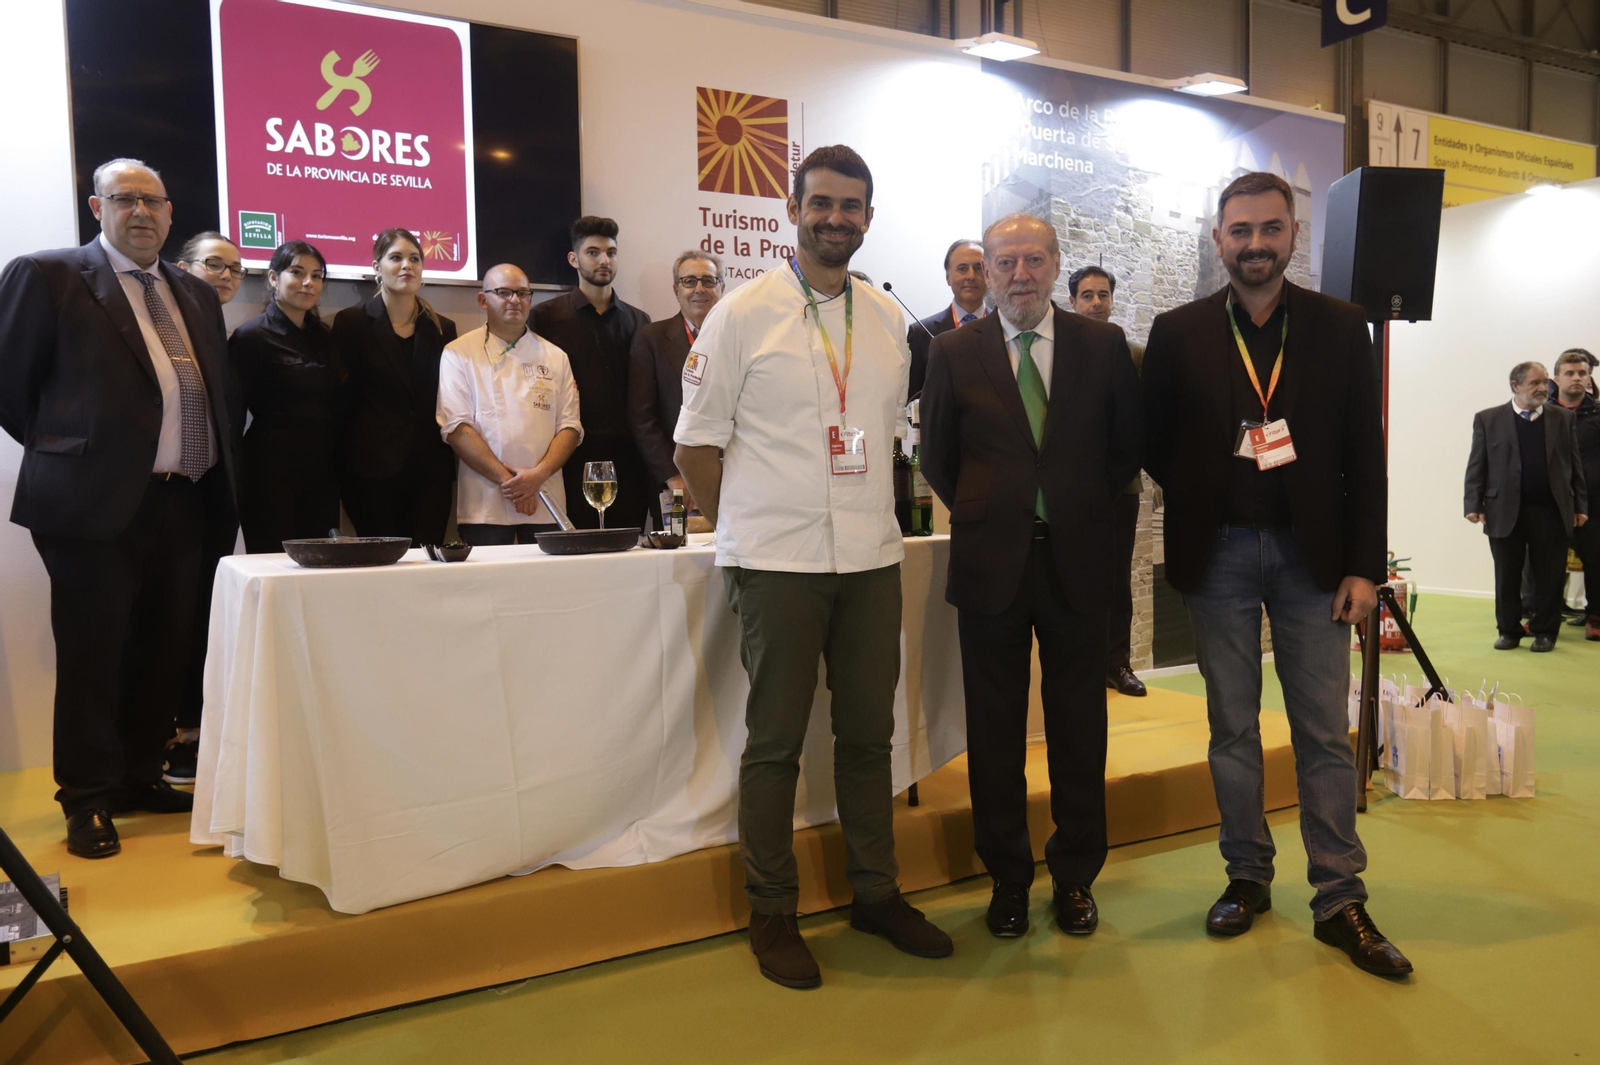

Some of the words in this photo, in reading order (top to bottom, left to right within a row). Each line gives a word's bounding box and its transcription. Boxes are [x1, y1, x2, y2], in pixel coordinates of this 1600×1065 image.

[1058, 100, 1080, 120] de
[1084, 104, 1099, 122] la
[1376, 112, 1384, 131] 9
[265, 117, 431, 168] SABORES
[1020, 120, 1076, 145] Puerta
[1080, 131, 1103, 150] de
[1412, 128, 1421, 161] 7
[1013, 147, 1094, 175] Marchena
[1433, 135, 1468, 151] Entidades
[1475, 143, 1514, 159] Organismos
[1515, 150, 1543, 165] Oficiales
[1543, 155, 1575, 170] Españoles
[266, 162, 283, 176] DE
[286, 164, 302, 178] LA
[304, 165, 370, 184] PROVINCIA
[372, 172, 388, 186] DE
[390, 174, 433, 190] SEVILLA
[1433, 155, 1460, 169] Spanish
[1461, 160, 1497, 176] Promotion
[1497, 167, 1520, 180] Boards
[698, 206, 779, 233] Turismo
[244, 232, 272, 240] SEVILLA
[700, 233, 725, 255] de
[734, 235, 751, 257] la
